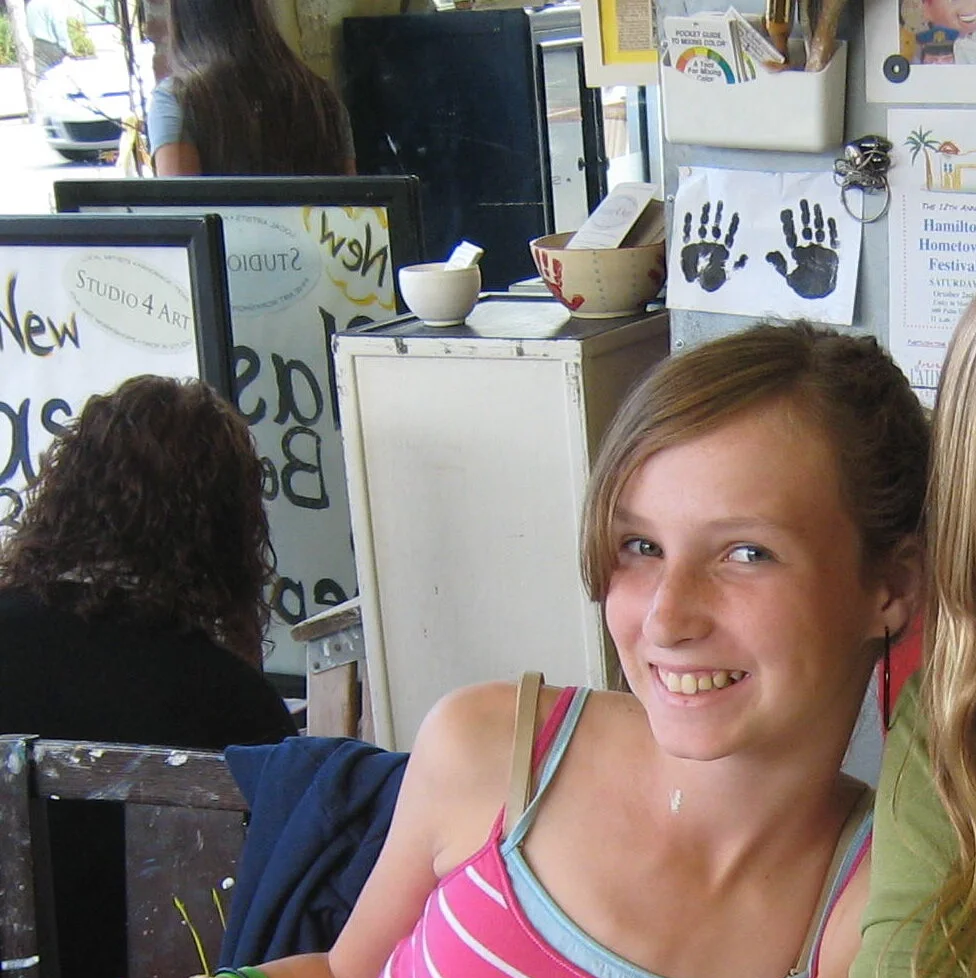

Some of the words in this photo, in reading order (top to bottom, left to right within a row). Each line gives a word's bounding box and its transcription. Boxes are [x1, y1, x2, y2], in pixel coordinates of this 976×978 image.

[0, 271, 80, 356] New
[76, 269, 138, 309] STUDIO
[142, 294, 153, 315] 4
[158, 303, 192, 329] ART
[929, 279, 976, 288] SATURDAY
